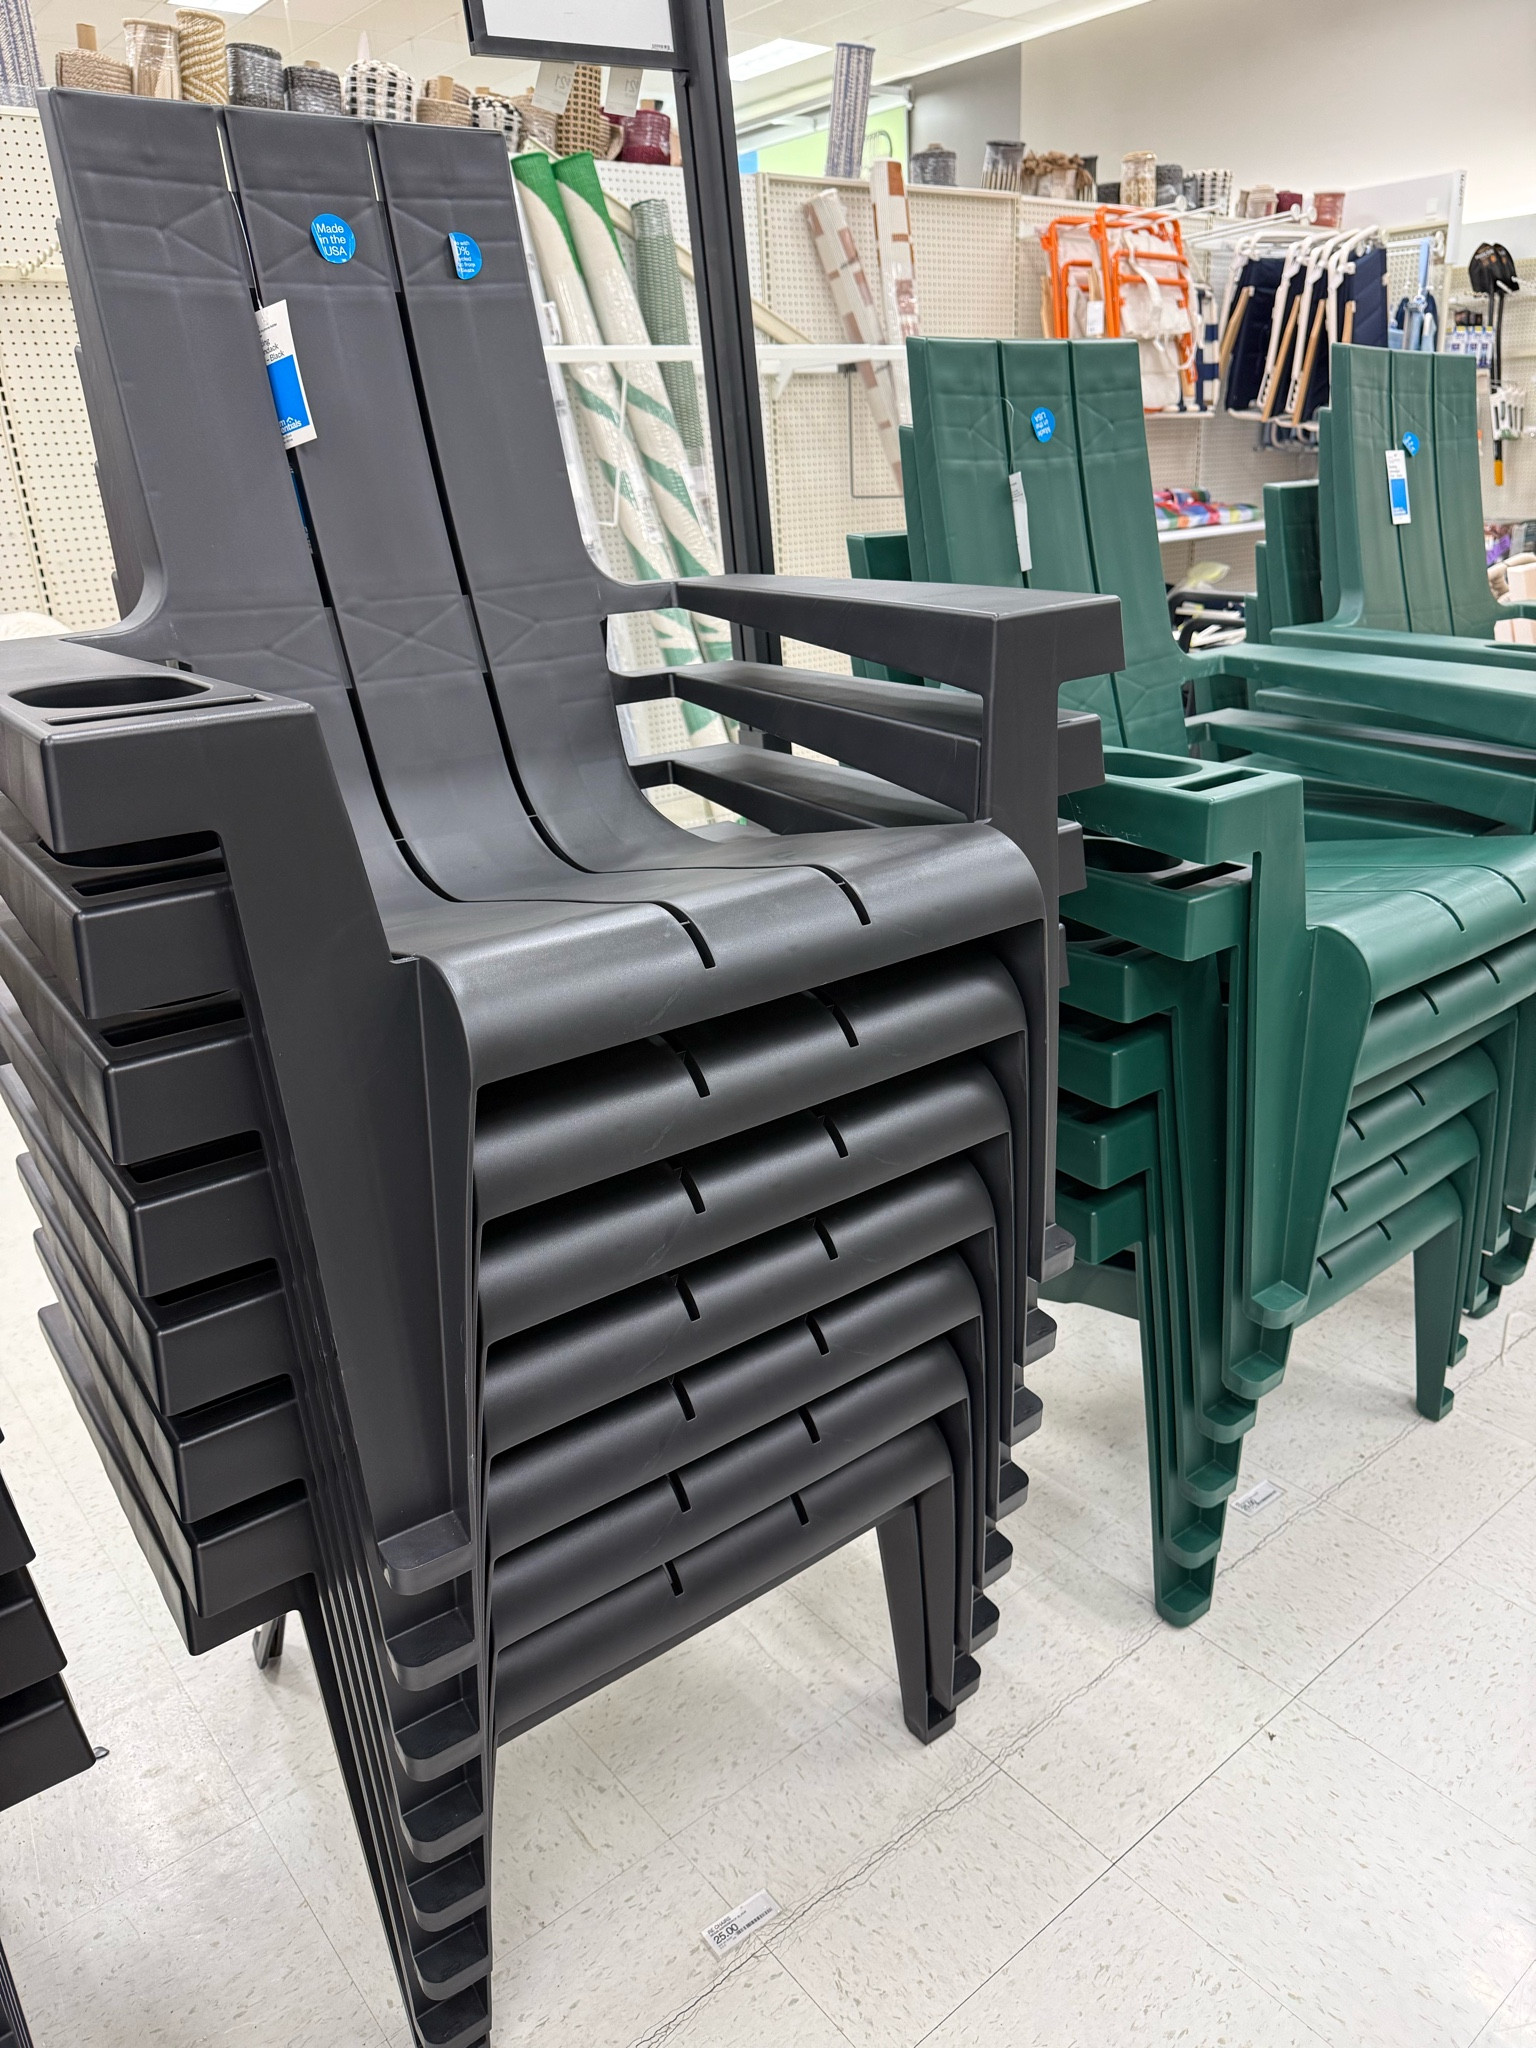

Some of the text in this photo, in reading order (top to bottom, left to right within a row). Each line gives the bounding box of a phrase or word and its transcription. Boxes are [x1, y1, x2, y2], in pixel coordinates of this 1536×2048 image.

[315, 223, 344, 234] Made
[319, 234, 347, 244] in the
[324, 245, 348, 256] USA
[270, 349, 285, 362] Black
[713, 1923, 739, 1944] 25.00
